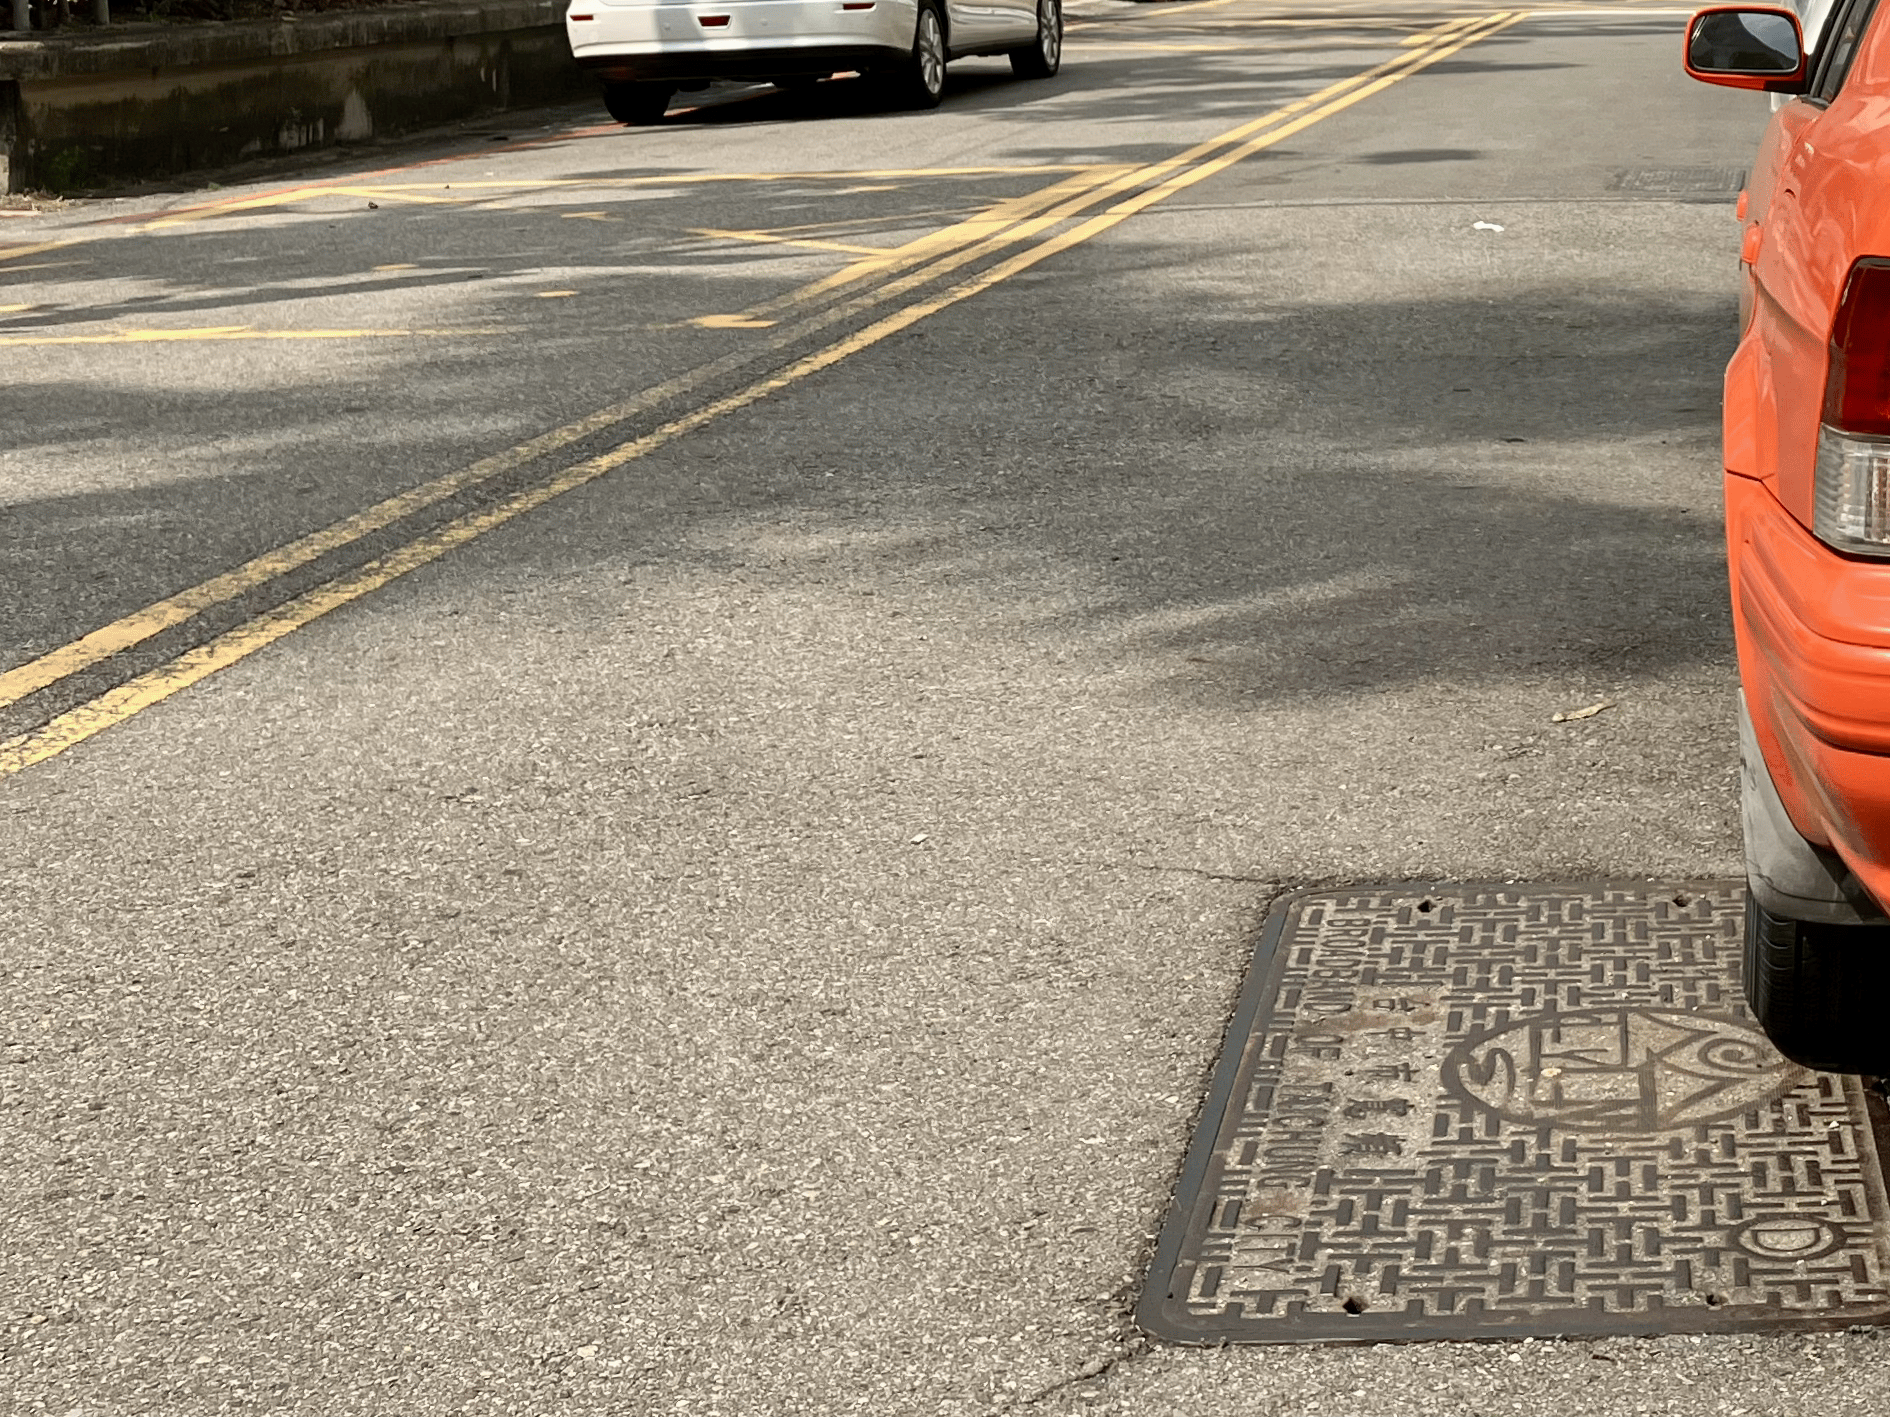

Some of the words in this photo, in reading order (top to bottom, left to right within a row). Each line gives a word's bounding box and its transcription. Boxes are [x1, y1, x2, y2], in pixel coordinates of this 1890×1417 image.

[1303, 918, 1371, 1013] BROADBAND
[1292, 1034, 1344, 1060] OF
[1257, 1082, 1333, 1188] TAICHUNG
[1232, 1215, 1303, 1275] CITY
